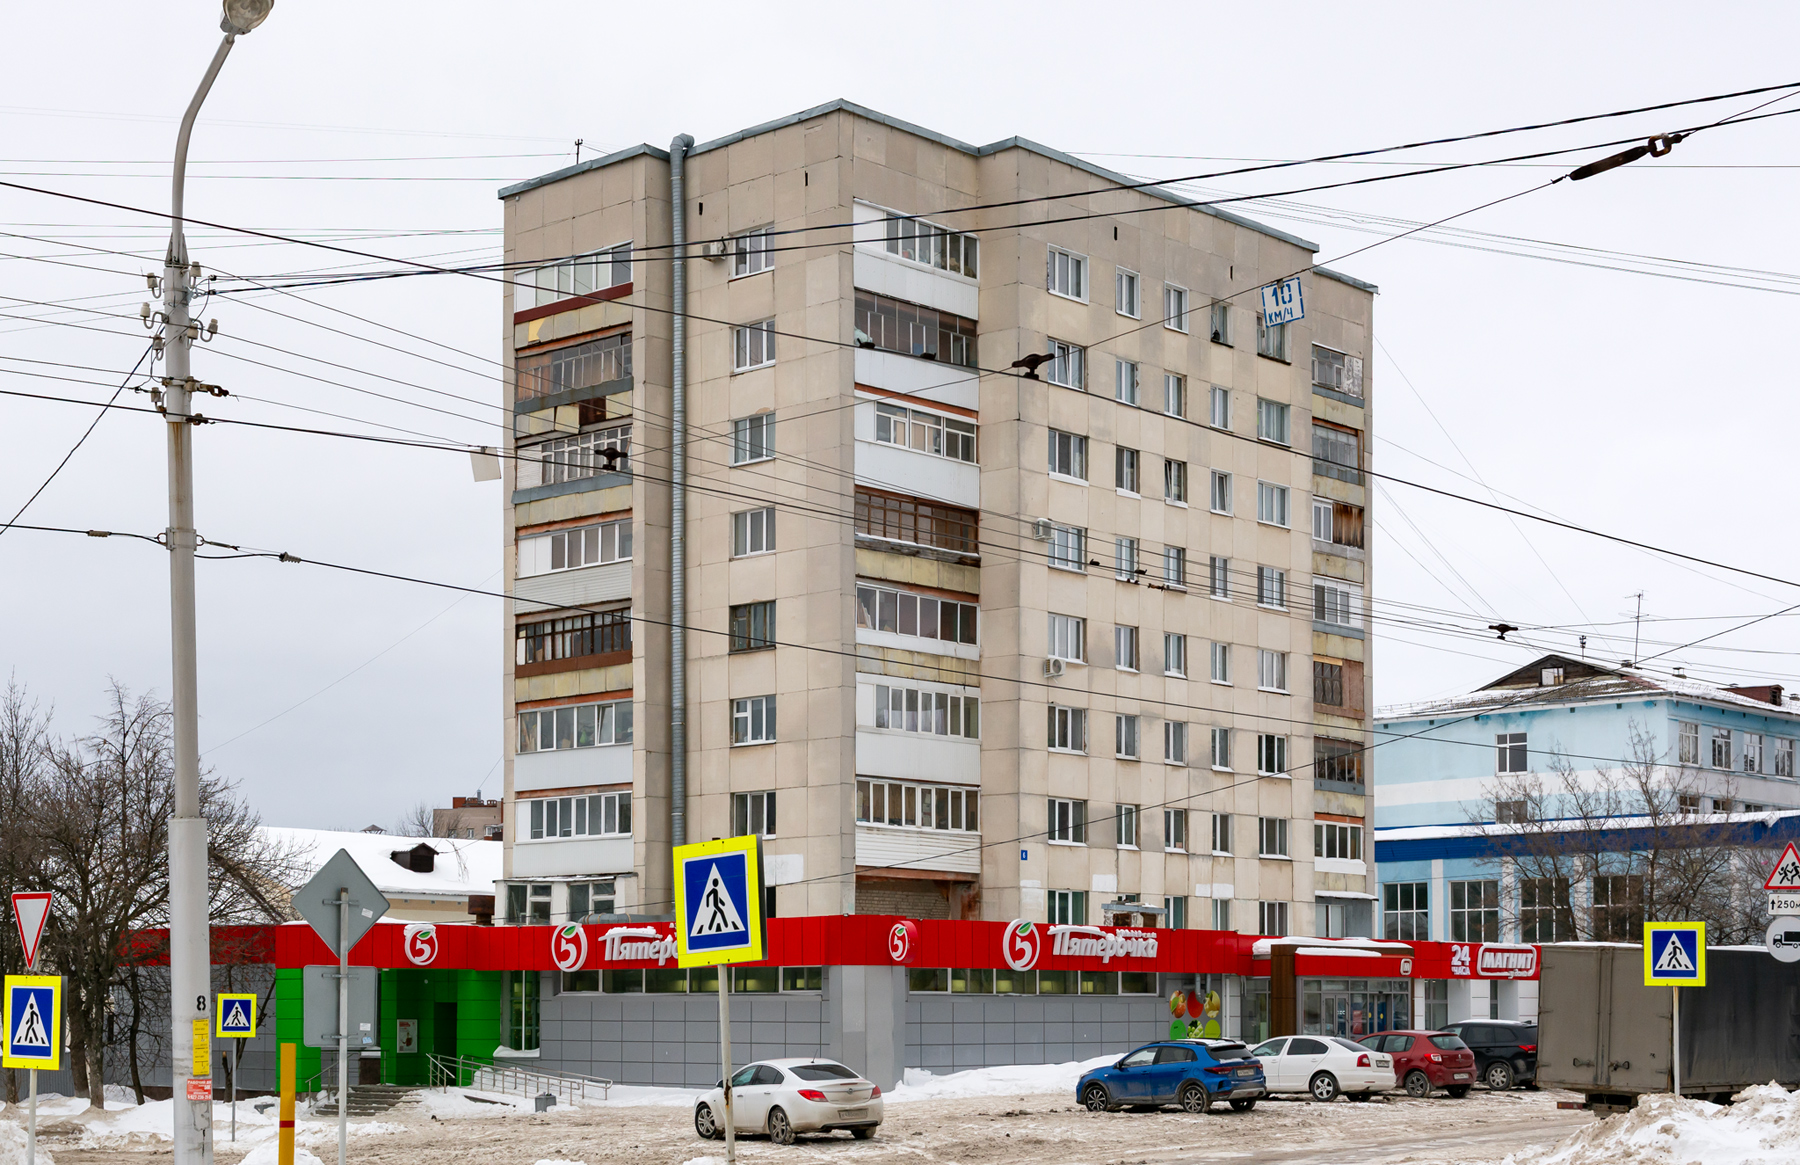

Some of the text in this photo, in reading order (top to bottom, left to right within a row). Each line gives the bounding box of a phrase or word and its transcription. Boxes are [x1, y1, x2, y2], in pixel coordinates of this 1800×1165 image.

[1272, 284, 1292, 307] 10
[1451, 944, 1471, 966] 24
[1481, 952, 1534, 968] МАГНИТ
[196, 995, 206, 1011] 8
